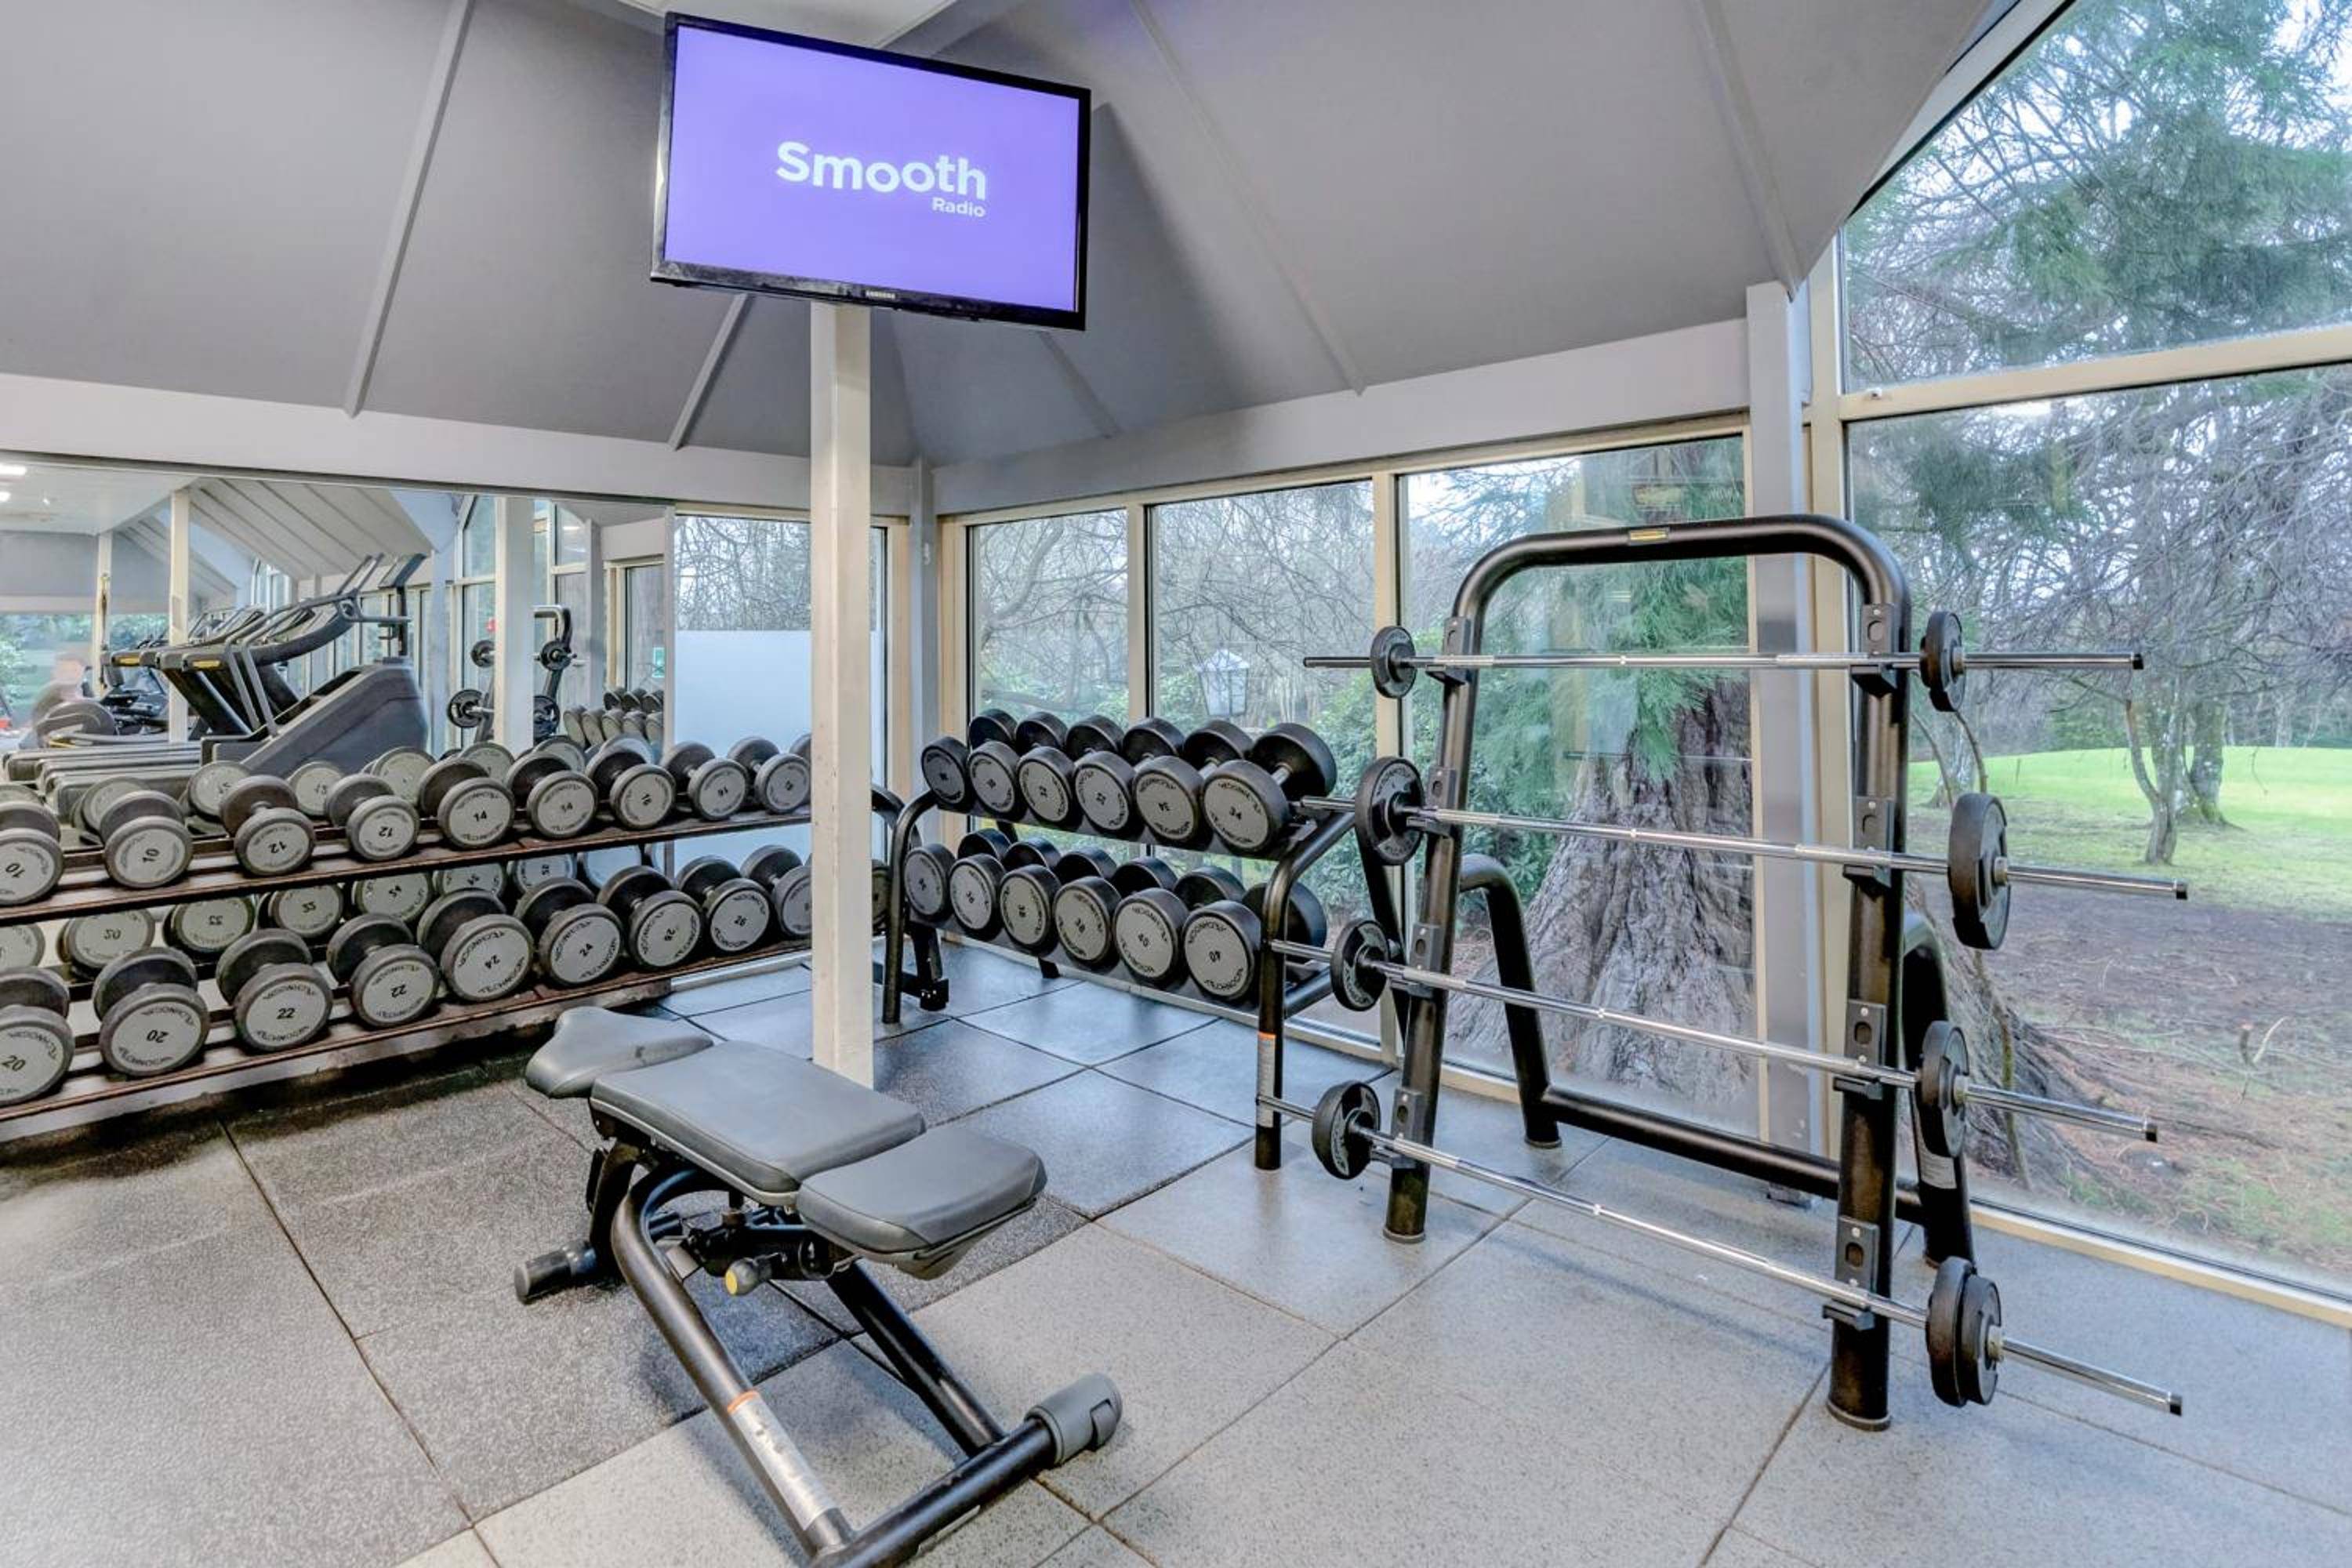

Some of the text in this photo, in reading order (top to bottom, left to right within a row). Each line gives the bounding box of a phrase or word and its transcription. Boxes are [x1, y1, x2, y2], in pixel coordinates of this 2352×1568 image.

[776, 141, 986, 200] Smooth
[932, 197, 986, 217] Radio
[561, 802, 573, 813] 14
[1229, 807, 1243, 821] 34
[473, 810, 488, 822] 14
[378, 826, 393, 838] 12
[268, 840, 287, 854] 12
[142, 848, 160, 863] 10
[5, 862, 26, 879] 10
[1138, 933, 1150, 948] 40
[579, 943, 593, 957] 24
[1208, 950, 1221, 963] 40
[485, 954, 500, 970] 24
[390, 984, 407, 999] 22
[276, 1007, 296, 1020] 22
[146, 1029, 169, 1044] 20
[1, 1054, 27, 1073] 20
